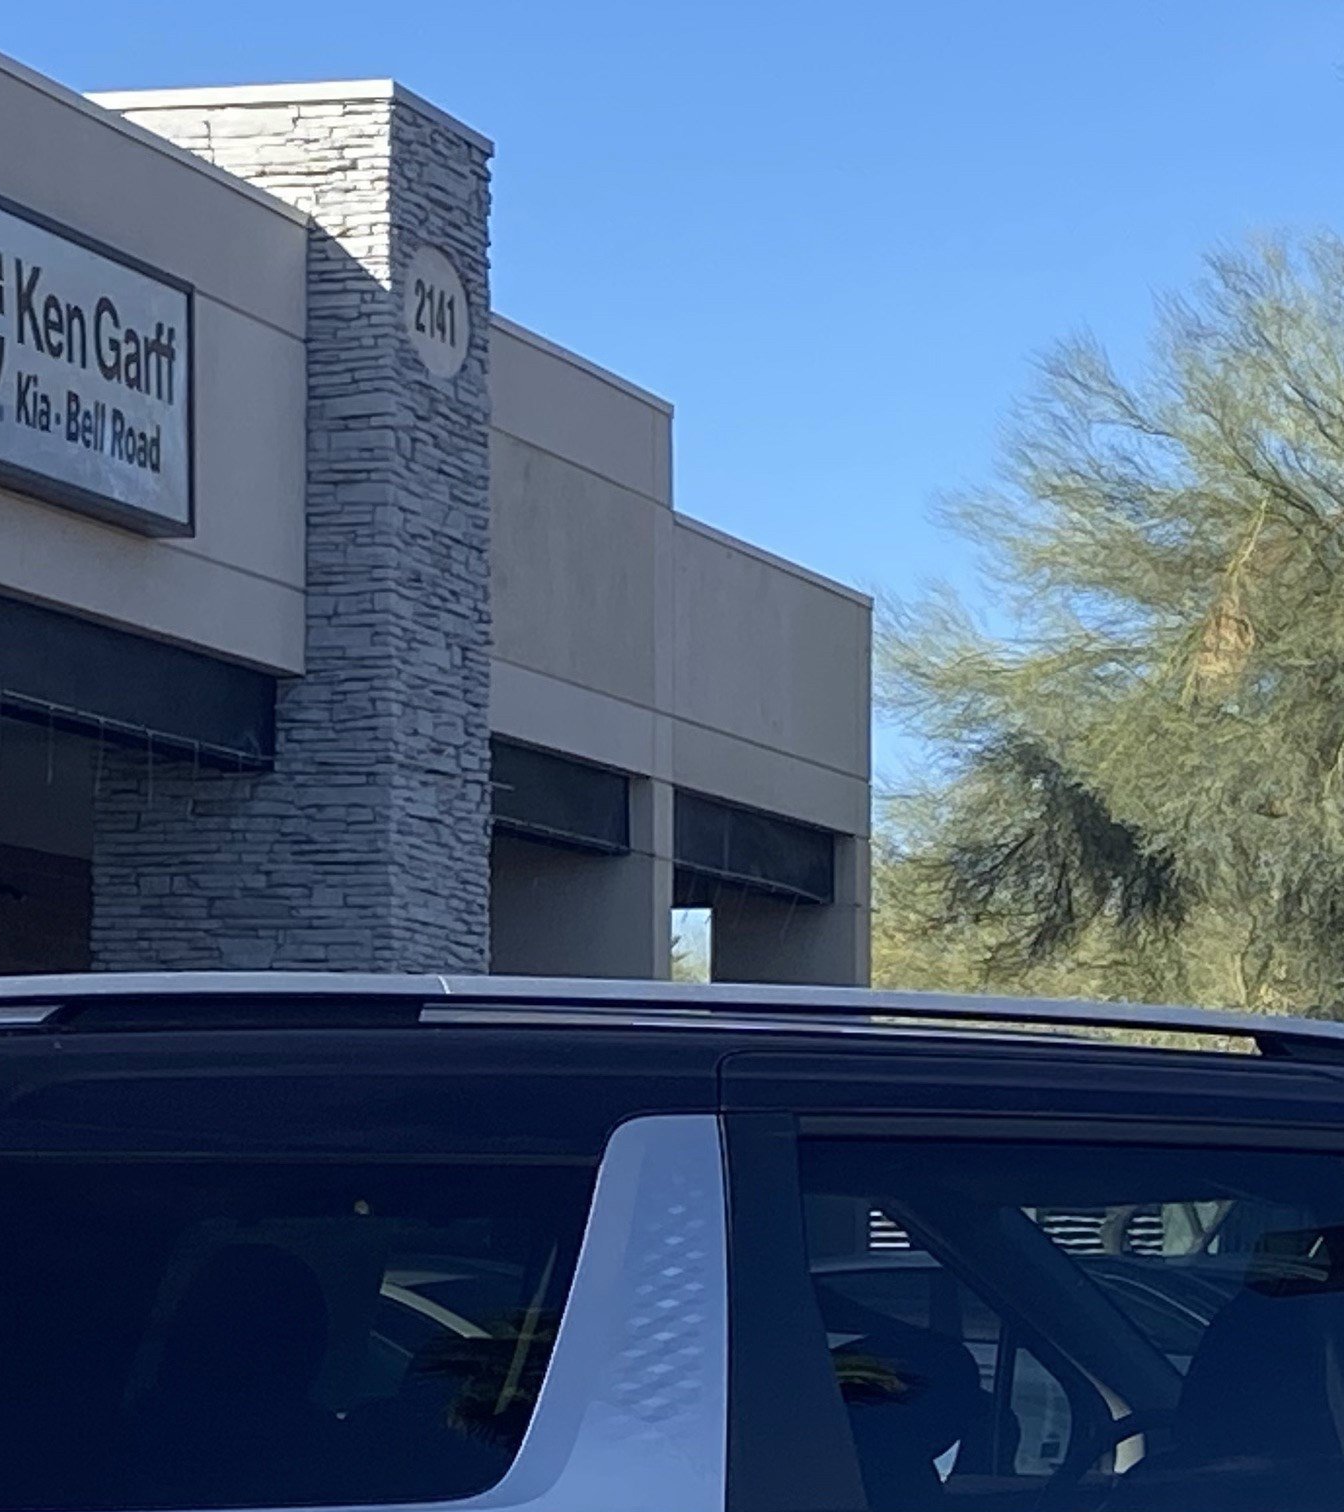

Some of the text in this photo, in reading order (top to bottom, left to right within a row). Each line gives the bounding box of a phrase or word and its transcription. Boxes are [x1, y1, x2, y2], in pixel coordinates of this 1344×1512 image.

[14, 257, 176, 405] Ken Garff
[414, 278, 455, 348] 2141
[15, 371, 52, 433] Kia
[66, 390, 106, 453] Bell
[110, 408, 161, 473] Road
